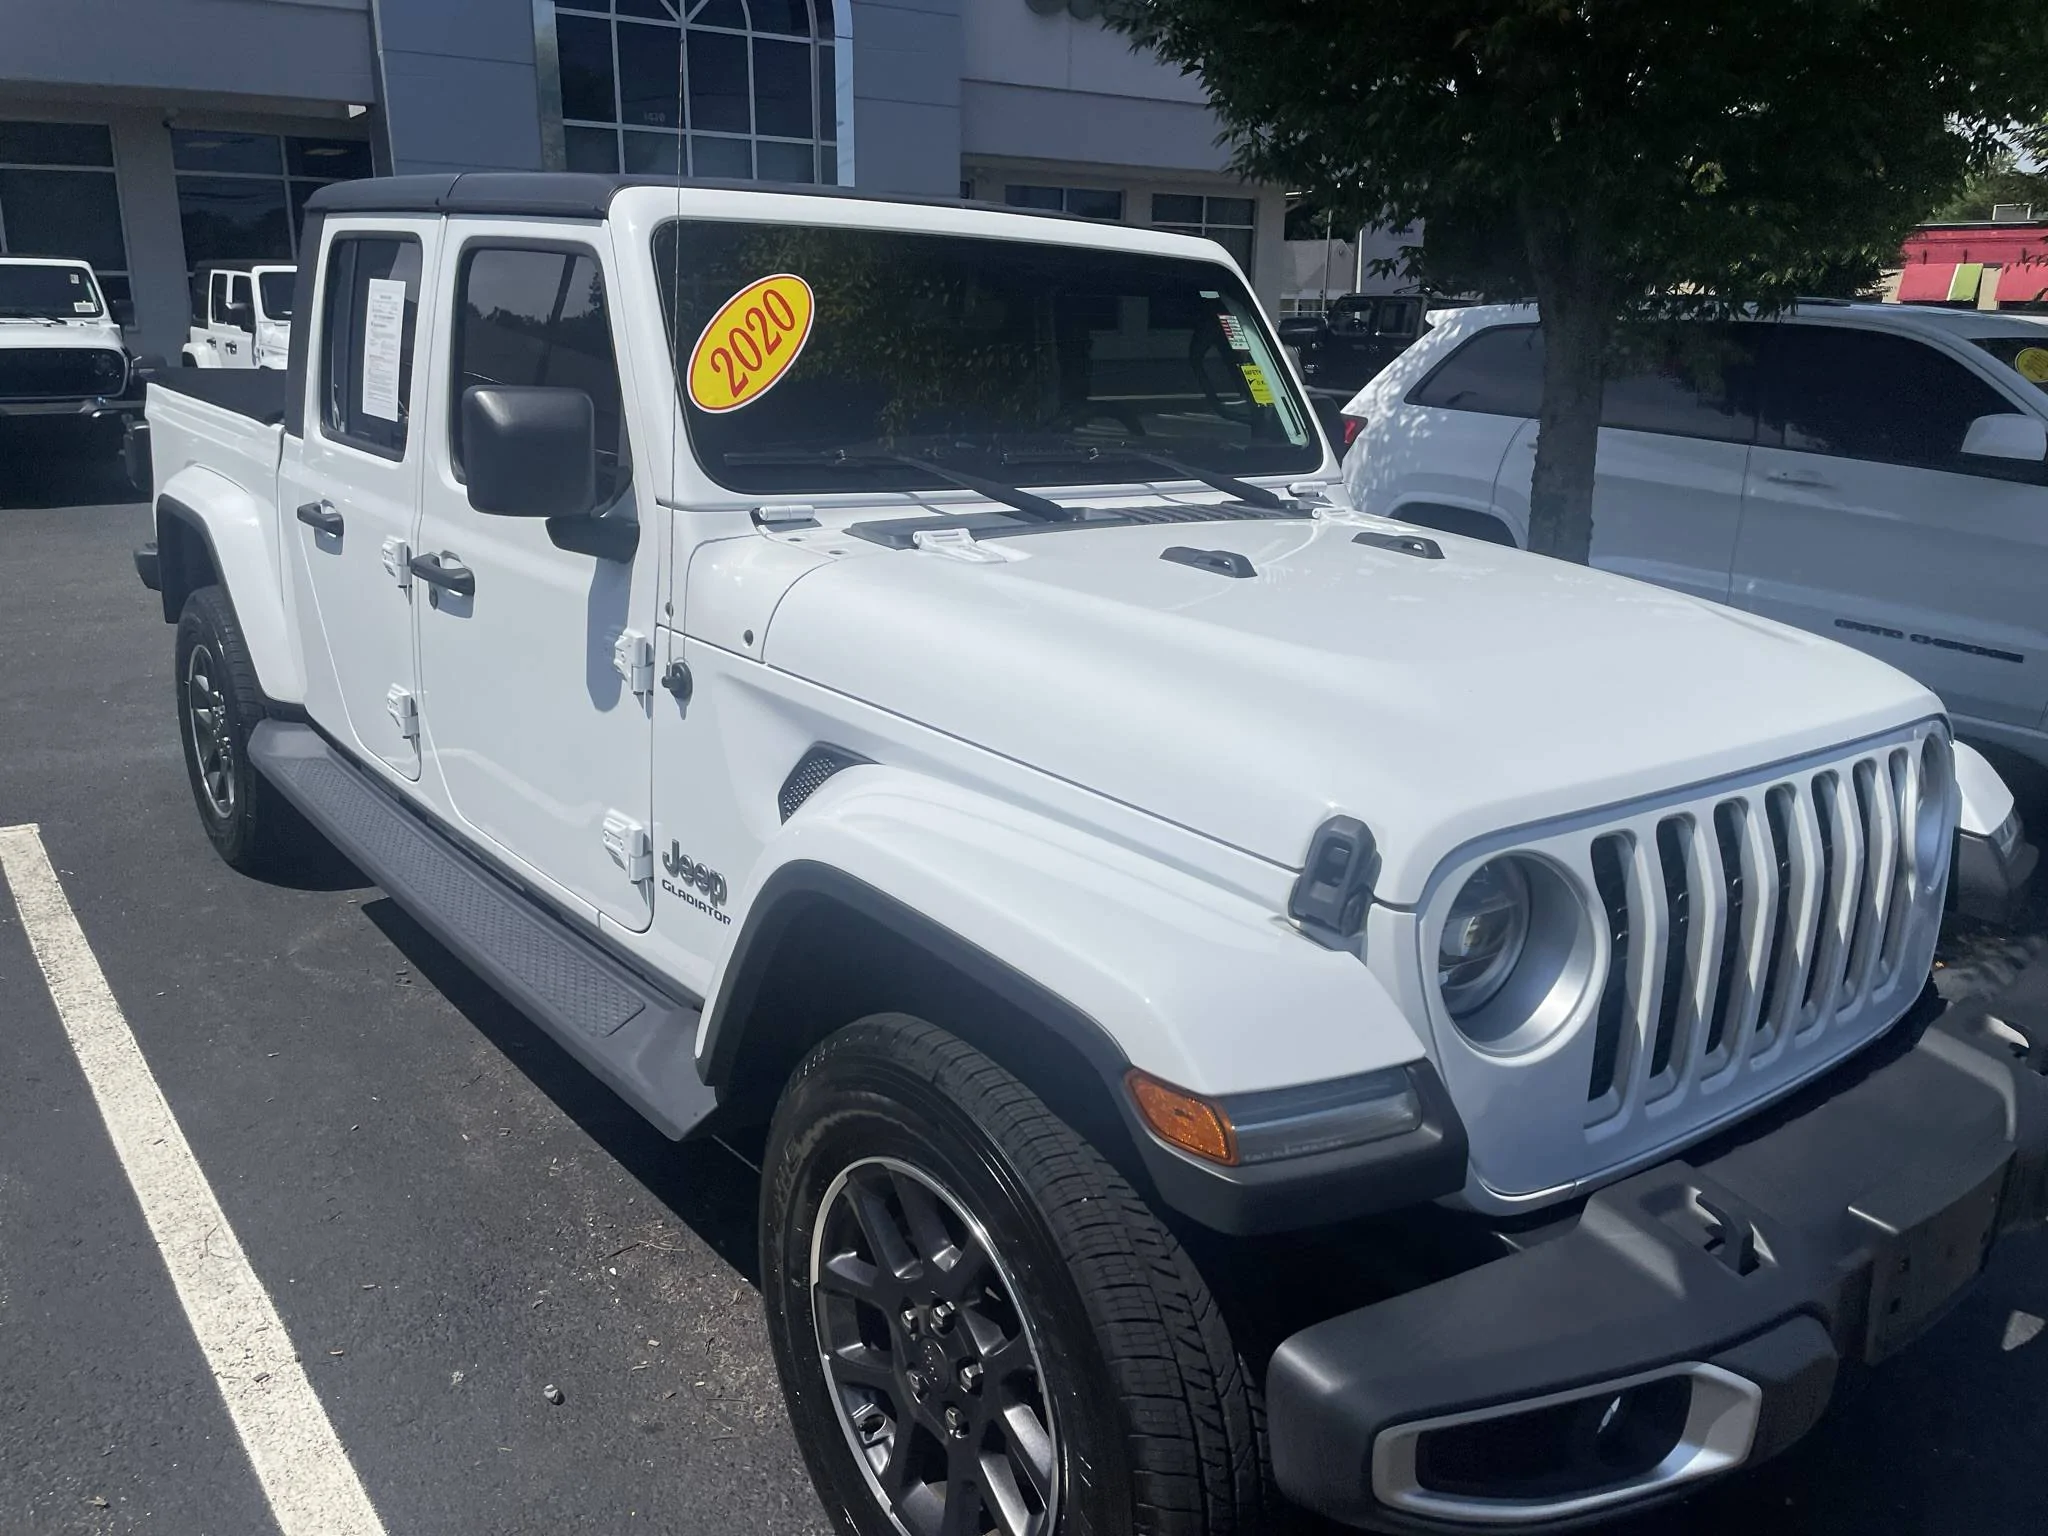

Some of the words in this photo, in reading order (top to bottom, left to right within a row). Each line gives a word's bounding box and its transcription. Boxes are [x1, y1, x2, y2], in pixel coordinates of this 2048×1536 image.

[711, 289, 795, 398] 2020
[662, 838, 728, 909] Jeep
[662, 879, 732, 926] GLADIATOR
